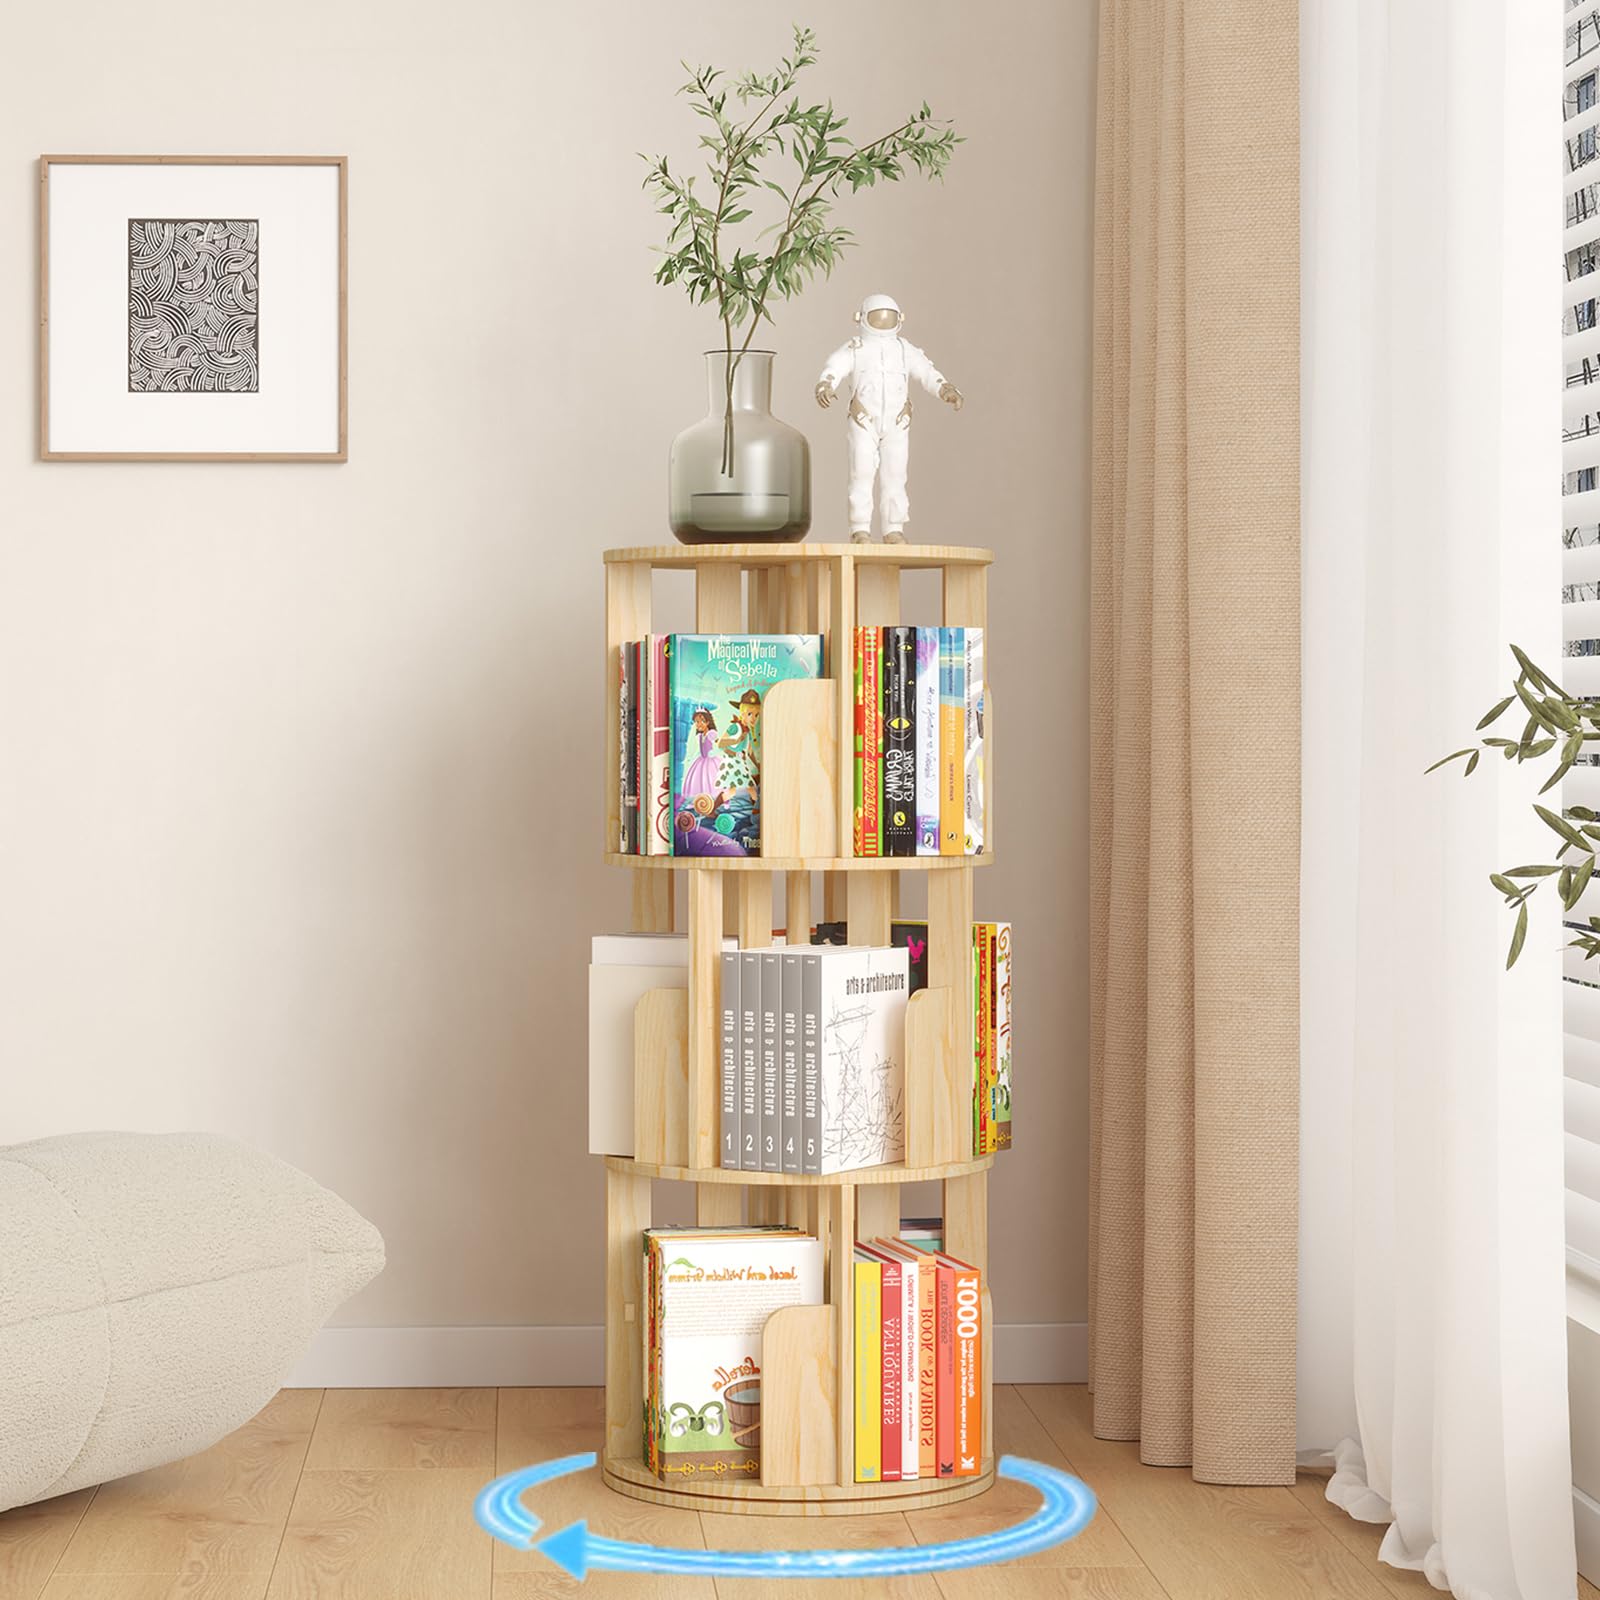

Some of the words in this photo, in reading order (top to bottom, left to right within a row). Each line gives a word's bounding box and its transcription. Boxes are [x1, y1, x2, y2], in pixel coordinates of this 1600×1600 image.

[708, 640, 749, 662] Magical
[749, 640, 777, 663] World
[725, 659, 778, 683] Sebella
[846, 976, 859, 995] arts
[866, 972, 904, 993] architecture
[724, 1009, 735, 1031] arts
[744, 1010, 755, 1032] arts
[765, 1011, 776, 1033] arts
[785, 1012, 796, 1034] arts
[805, 1013, 816, 1035] arts
[724, 1048, 736, 1113] architecture
[744, 1049, 756, 1114] architecture
[765, 1050, 776, 1115] architecture
[785, 1051, 797, 1117] architecture
[805, 1052, 817, 1118] architecture
[726, 1132, 732, 1150] 1
[745, 1134, 753, 1151] 2
[766, 1135, 773, 1152] 3
[786, 1137, 794, 1154] 4
[807, 1138, 814, 1156] 5
